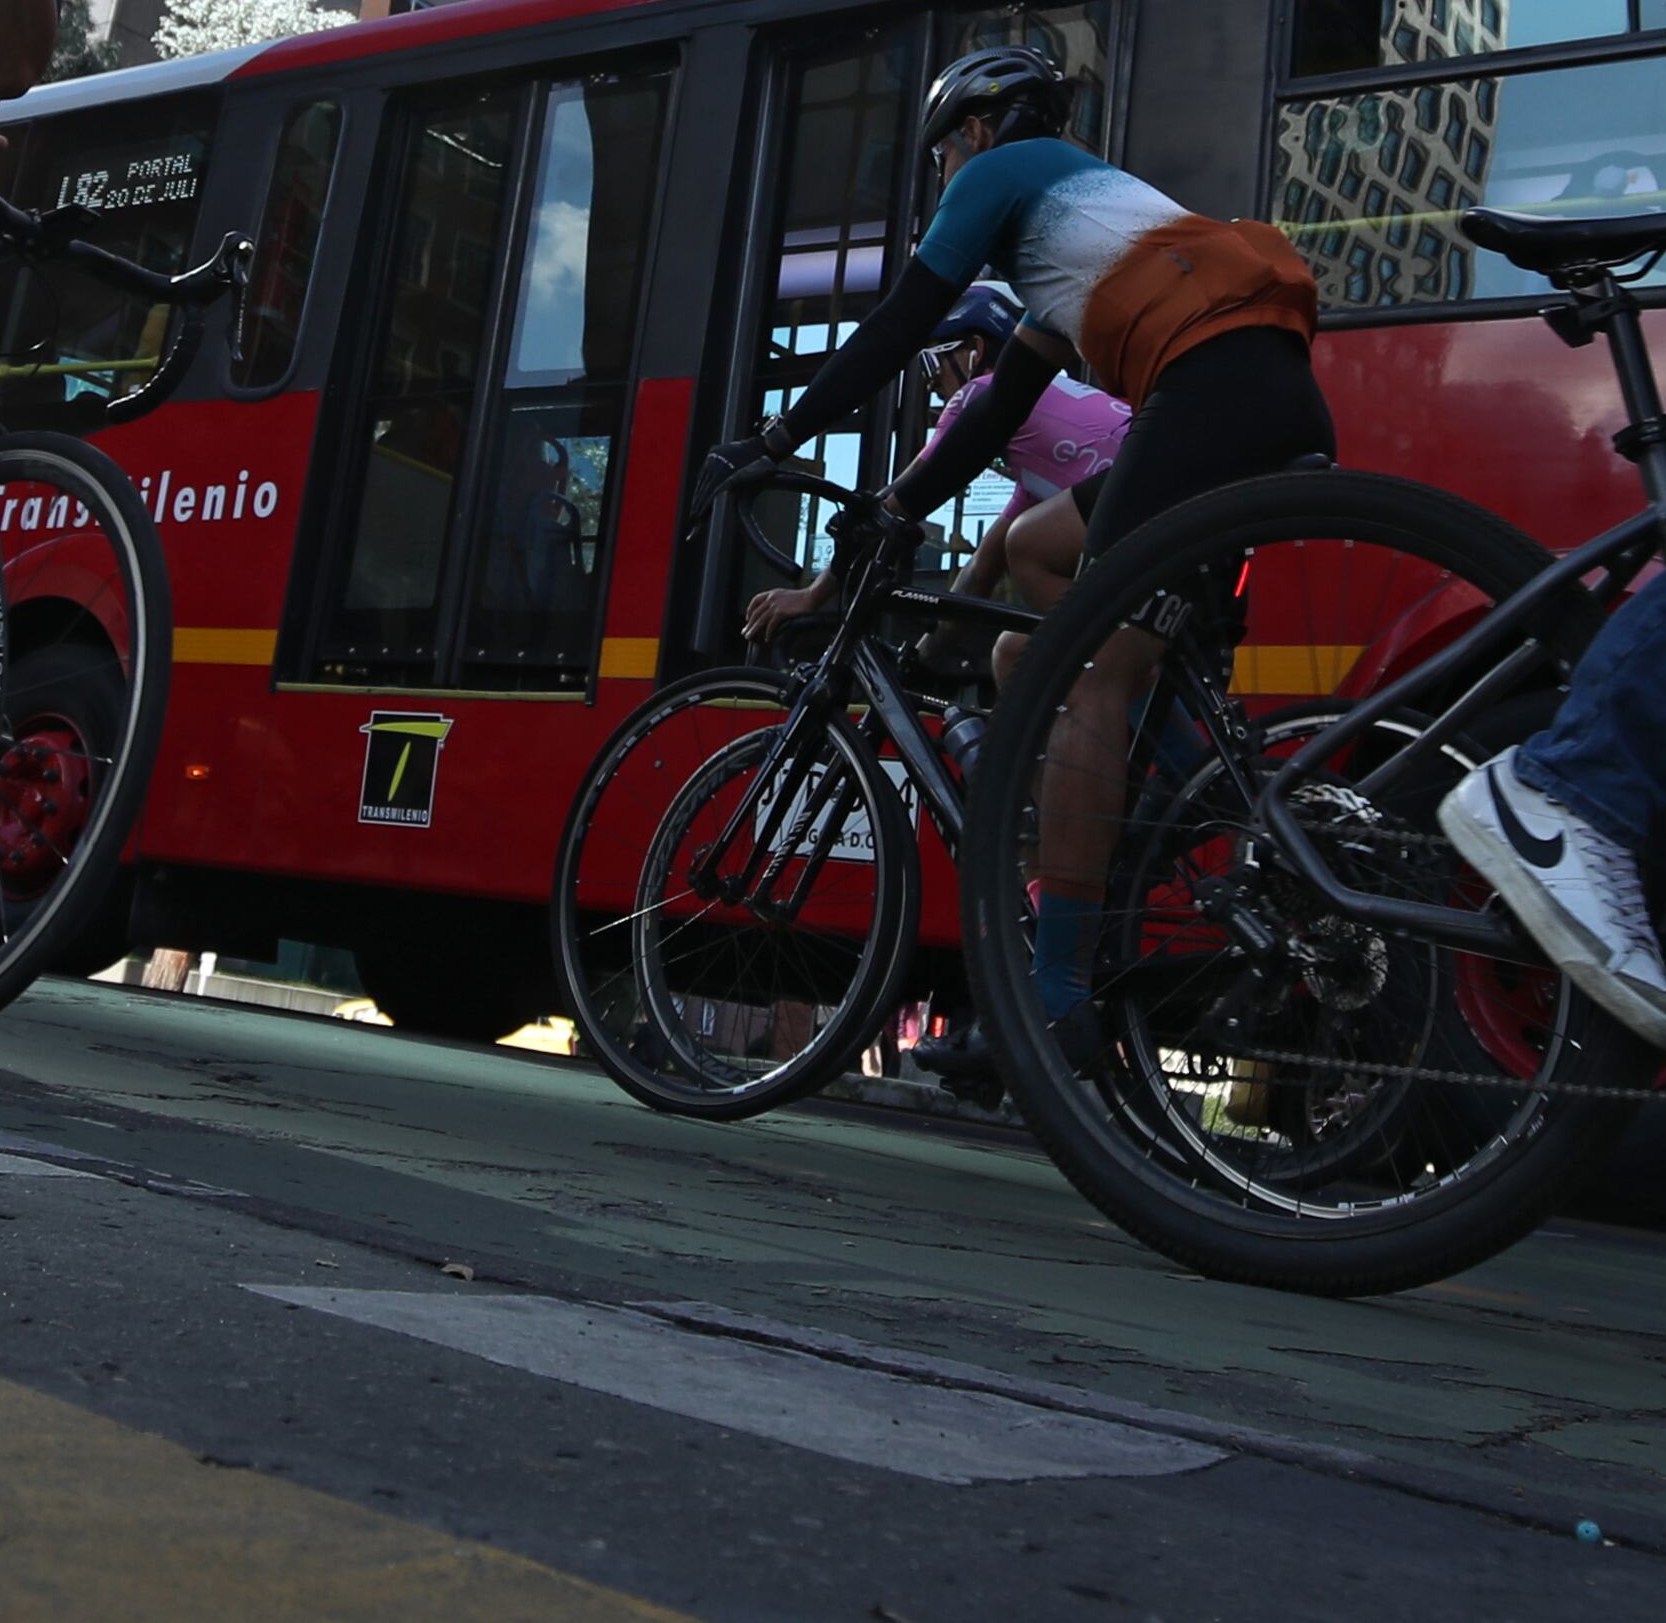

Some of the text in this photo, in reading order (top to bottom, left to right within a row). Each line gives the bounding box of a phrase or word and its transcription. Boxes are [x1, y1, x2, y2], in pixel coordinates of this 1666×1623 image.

[127, 154, 192, 180] PORTAL
[56, 170, 109, 209] L82
[104, 188, 129, 209] 20
[132, 184, 156, 205] DE
[362, 805, 429, 822] TRANSMILENIO
